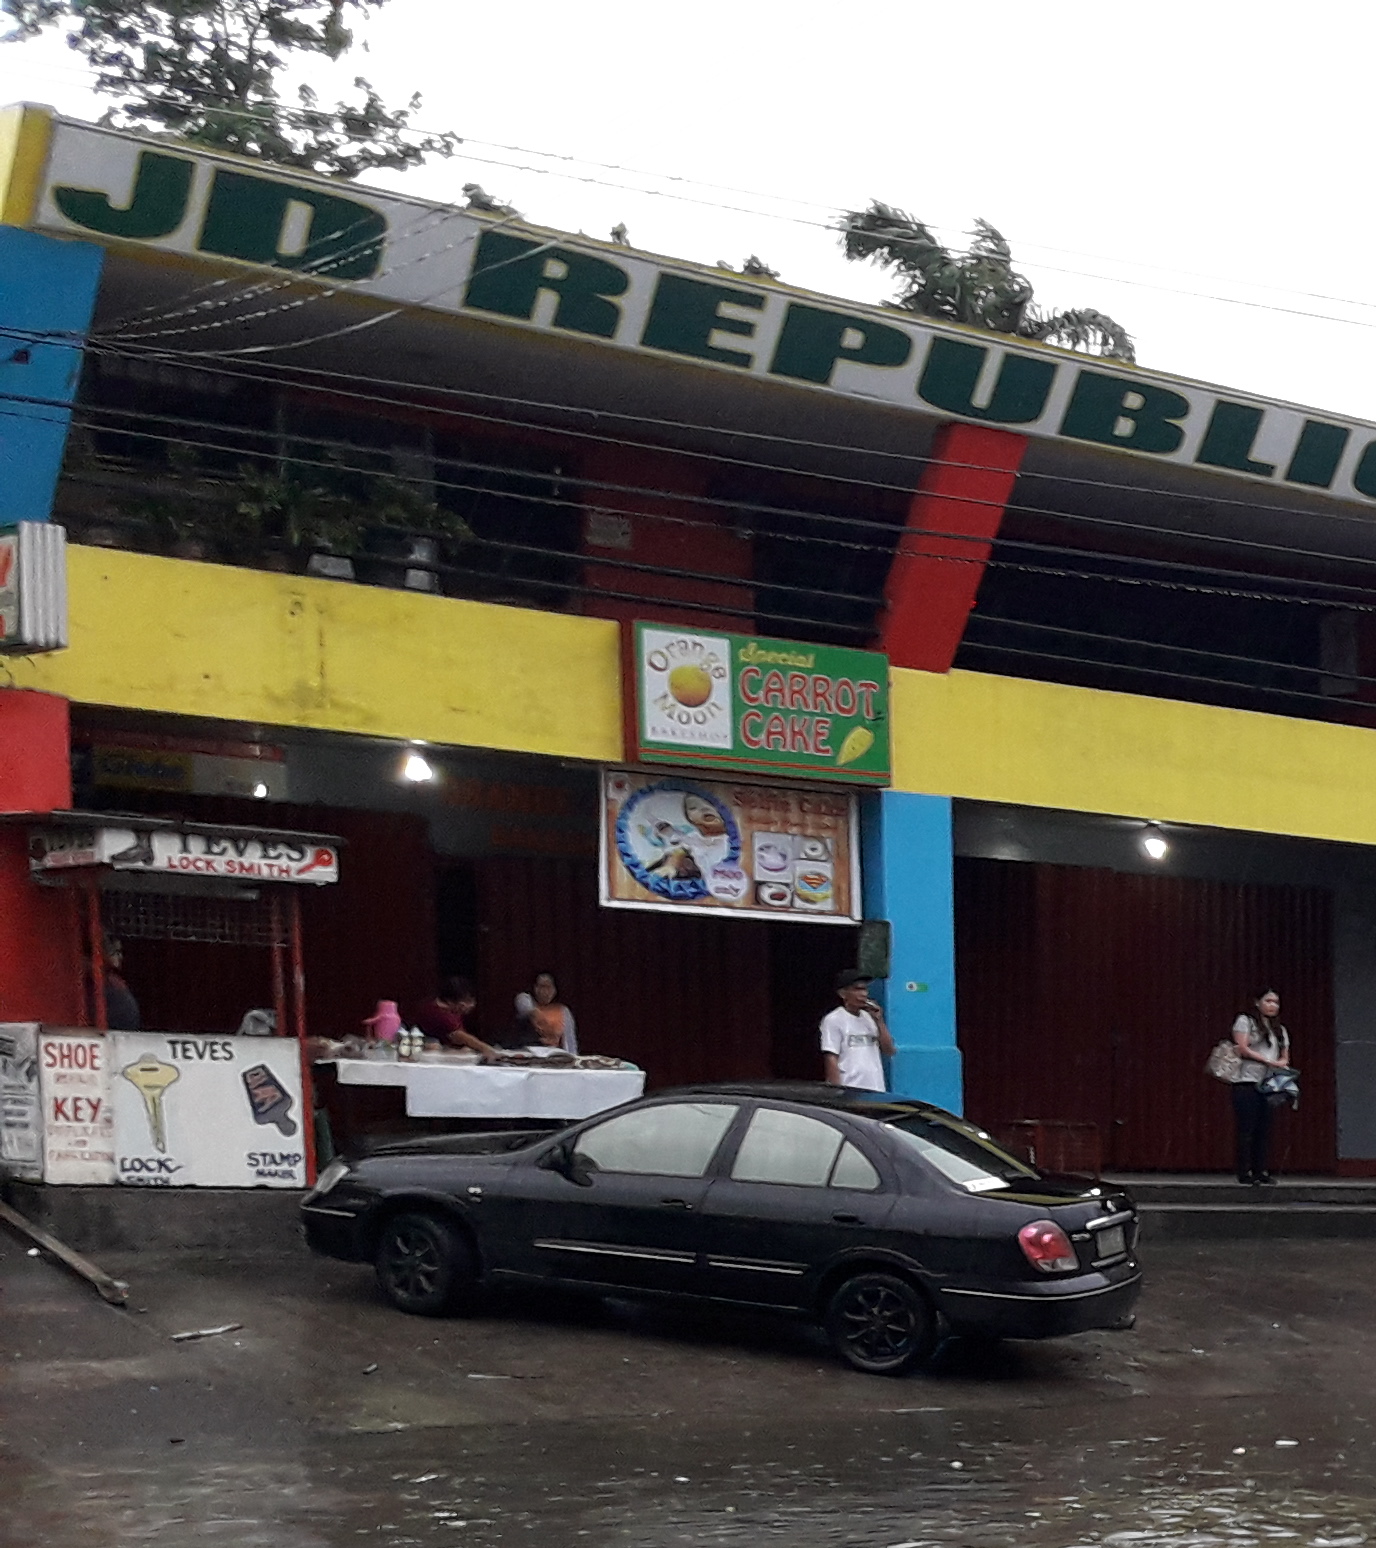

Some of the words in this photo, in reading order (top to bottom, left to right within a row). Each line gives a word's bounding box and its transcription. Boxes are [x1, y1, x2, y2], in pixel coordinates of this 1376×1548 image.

[55, 150, 389, 281] JD
[647, 638, 727, 680] Orange
[738, 666, 880, 719] CARROT
[741, 710, 833, 757] CAKE
[167, 856, 217, 874] LOCK
[225, 859, 292, 878] SMITH
[43, 1041, 102, 1071] SHOE
[166, 1040, 235, 1062] TEVES
[54, 1096, 102, 1123] KEY
[119, 1156, 184, 1175] LOCK
